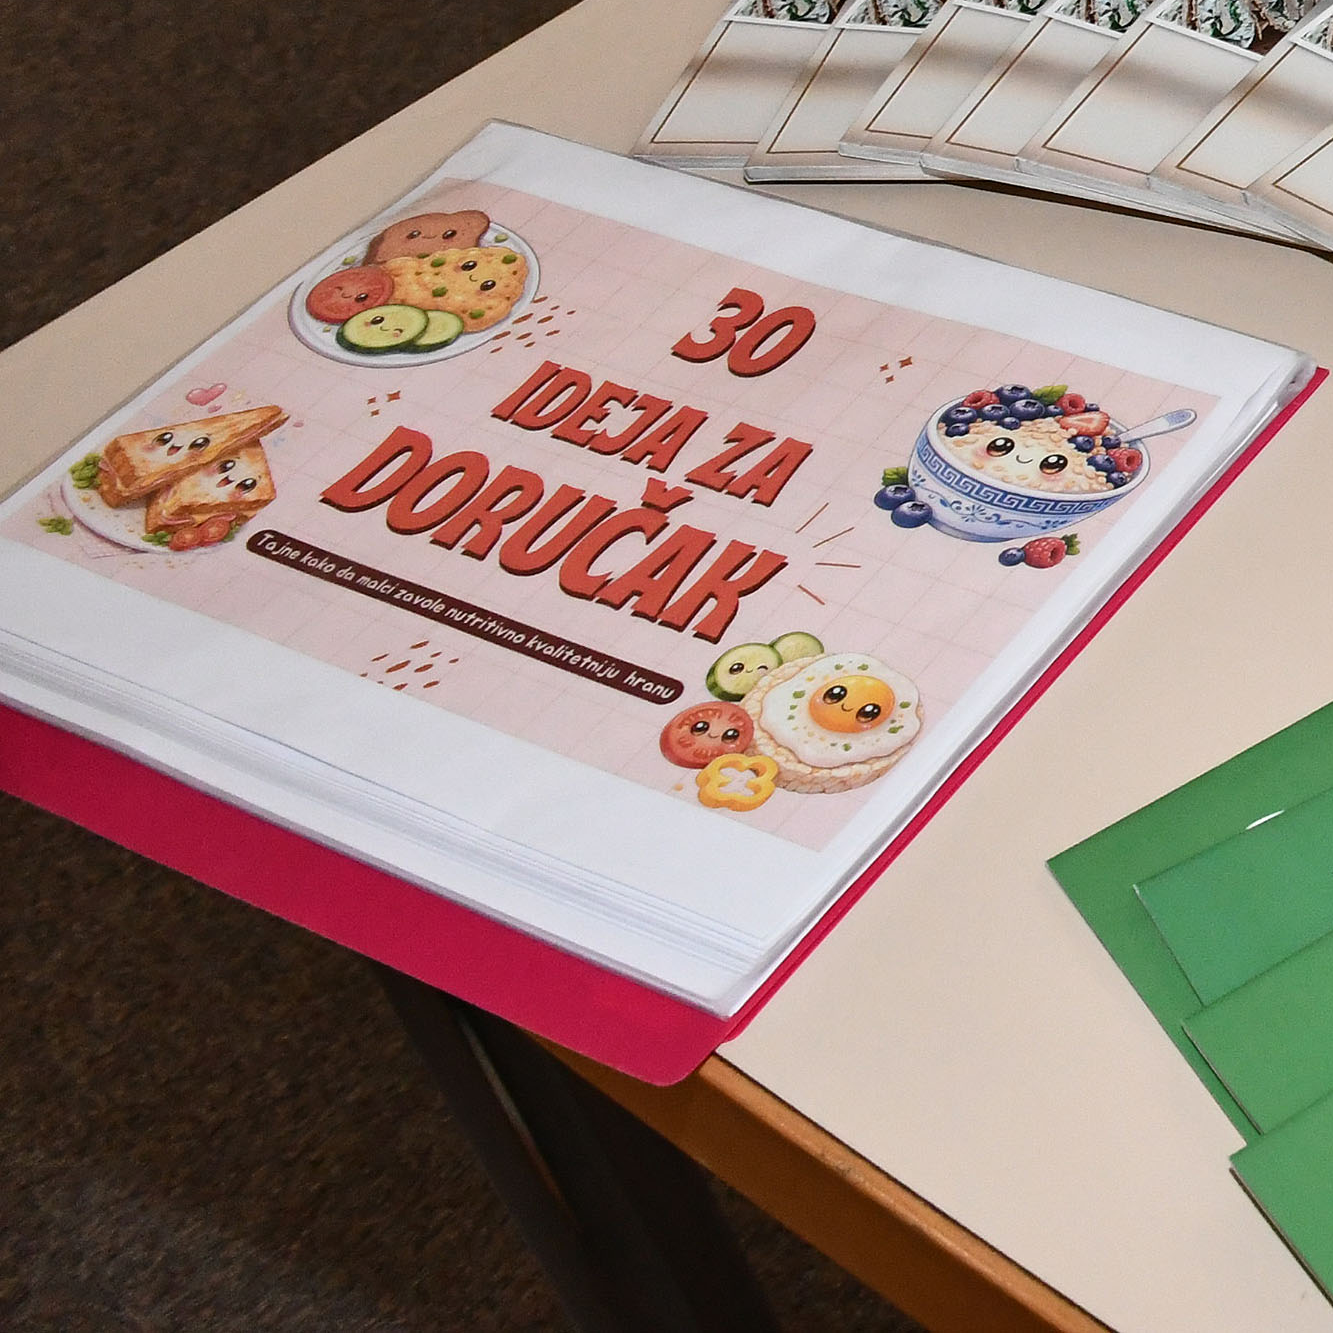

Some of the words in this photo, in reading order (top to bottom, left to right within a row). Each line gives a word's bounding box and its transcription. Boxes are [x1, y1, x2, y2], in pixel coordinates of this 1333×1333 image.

[671, 287, 816, 377] 30
[491, 359, 709, 472] IDEJA
[684, 421, 813, 507] ZA
[319, 425, 789, 645] DORUČAK
[300, 550, 334, 574] kako
[336, 567, 355, 581] da
[356, 574, 397, 595] malci
[394, 588, 445, 613] zavole
[444, 608, 526, 644] nutritivno
[526, 635, 621, 679] kvalitetniju
[623, 671, 675, 699] hranu
